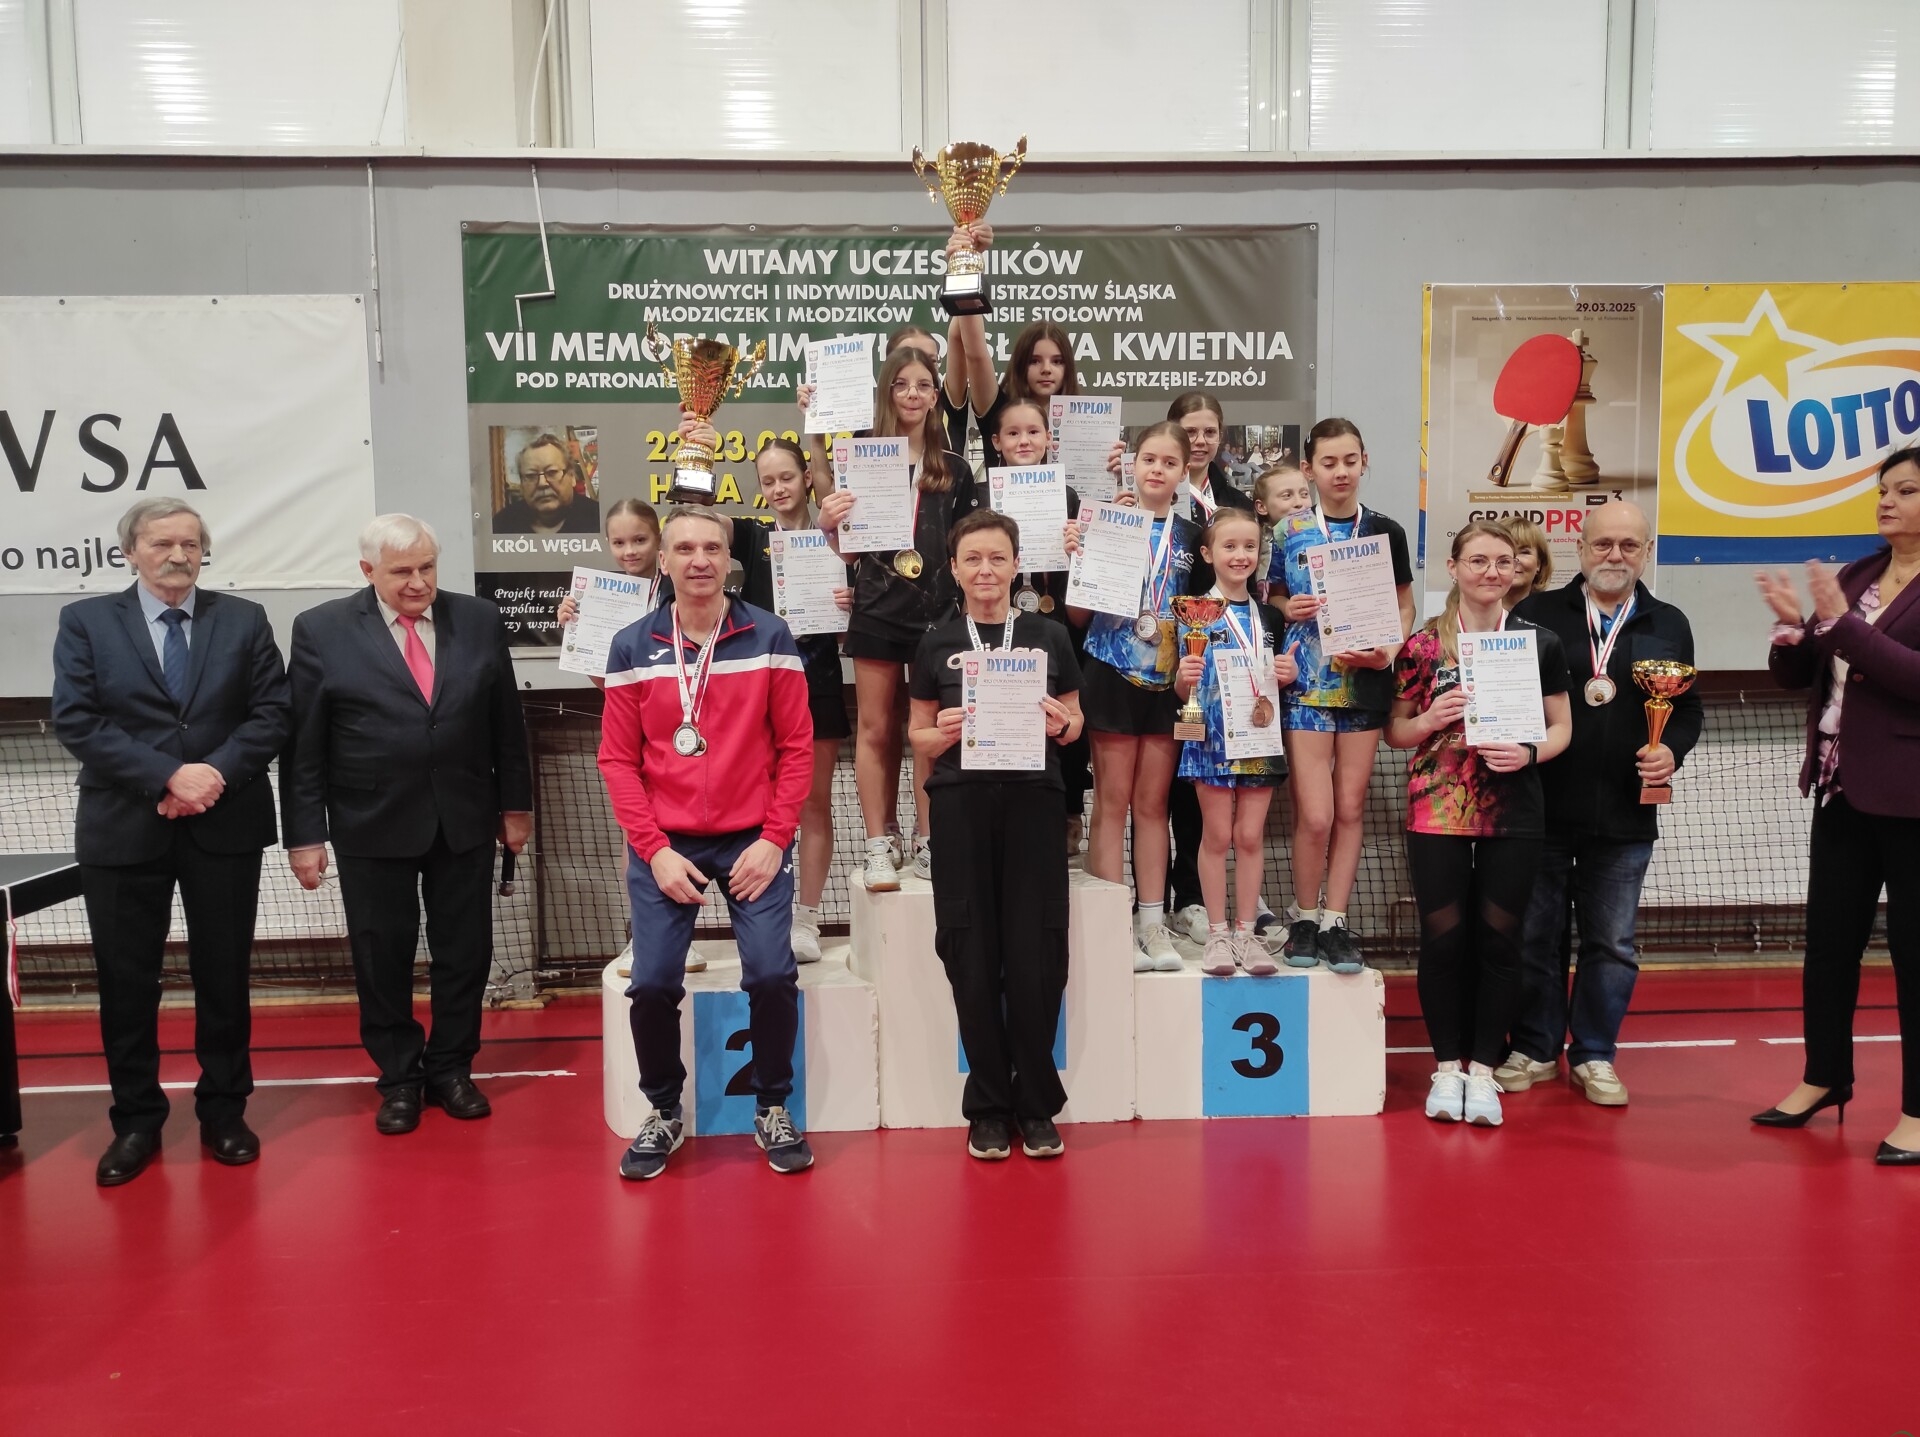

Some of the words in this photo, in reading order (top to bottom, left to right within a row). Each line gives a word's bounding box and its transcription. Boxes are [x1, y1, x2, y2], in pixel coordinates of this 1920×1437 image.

[704, 249, 837, 275] WITAMY
[849, 242, 1083, 275] UCZESIKÓW
[608, 278, 768, 300] DRUŻYNOWYCH
[775, 284, 780, 300] I
[786, 284, 942, 300] INDYWIDUALNY
[991, 284, 1098, 300] ISTRZOSTW
[1104, 280, 1176, 303] ŚLĄSKA
[643, 306, 769, 323] MŁODZICZEK
[775, 306, 781, 322] I
[787, 302, 913, 323] MŁODZIKÓW
[1031, 306, 1143, 323] STOŁOWYM
[1576, 302, 1636, 312] 29.03.2025
[485, 332, 537, 361] VII
[824, 341, 863, 356] DYPLOM
[1113, 331, 1293, 361] KWIETNIA
[516, 372, 559, 388] POD
[565, 372, 677, 388] PATRONATE
[1092, 370, 1266, 391] JASTRZĘBIE-ZDRÓJ
[1069, 401, 1112, 414] DYPLOM
[1747, 379, 1920, 473] LOTTO
[78, 413, 207, 493] SA
[855, 444, 900, 458] DYPLOM
[1010, 471, 1056, 484] DYPLOM
[1099, 508, 1145, 528] DYPLOM
[492, 536, 537, 553] KRÓL
[541, 538, 602, 555] WĘGLA
[790, 535, 828, 548] DYPLO
[1330, 542, 1380, 562] DYPLOM
[494, 587, 535, 601] Projekt
[539, 586, 571, 599] realiz
[594, 576, 641, 596] DYPLOM
[1480, 637, 1527, 651] DYPLOM
[986, 659, 1037, 672] DYPLOM
[1231, 1012, 1283, 1078] 3
